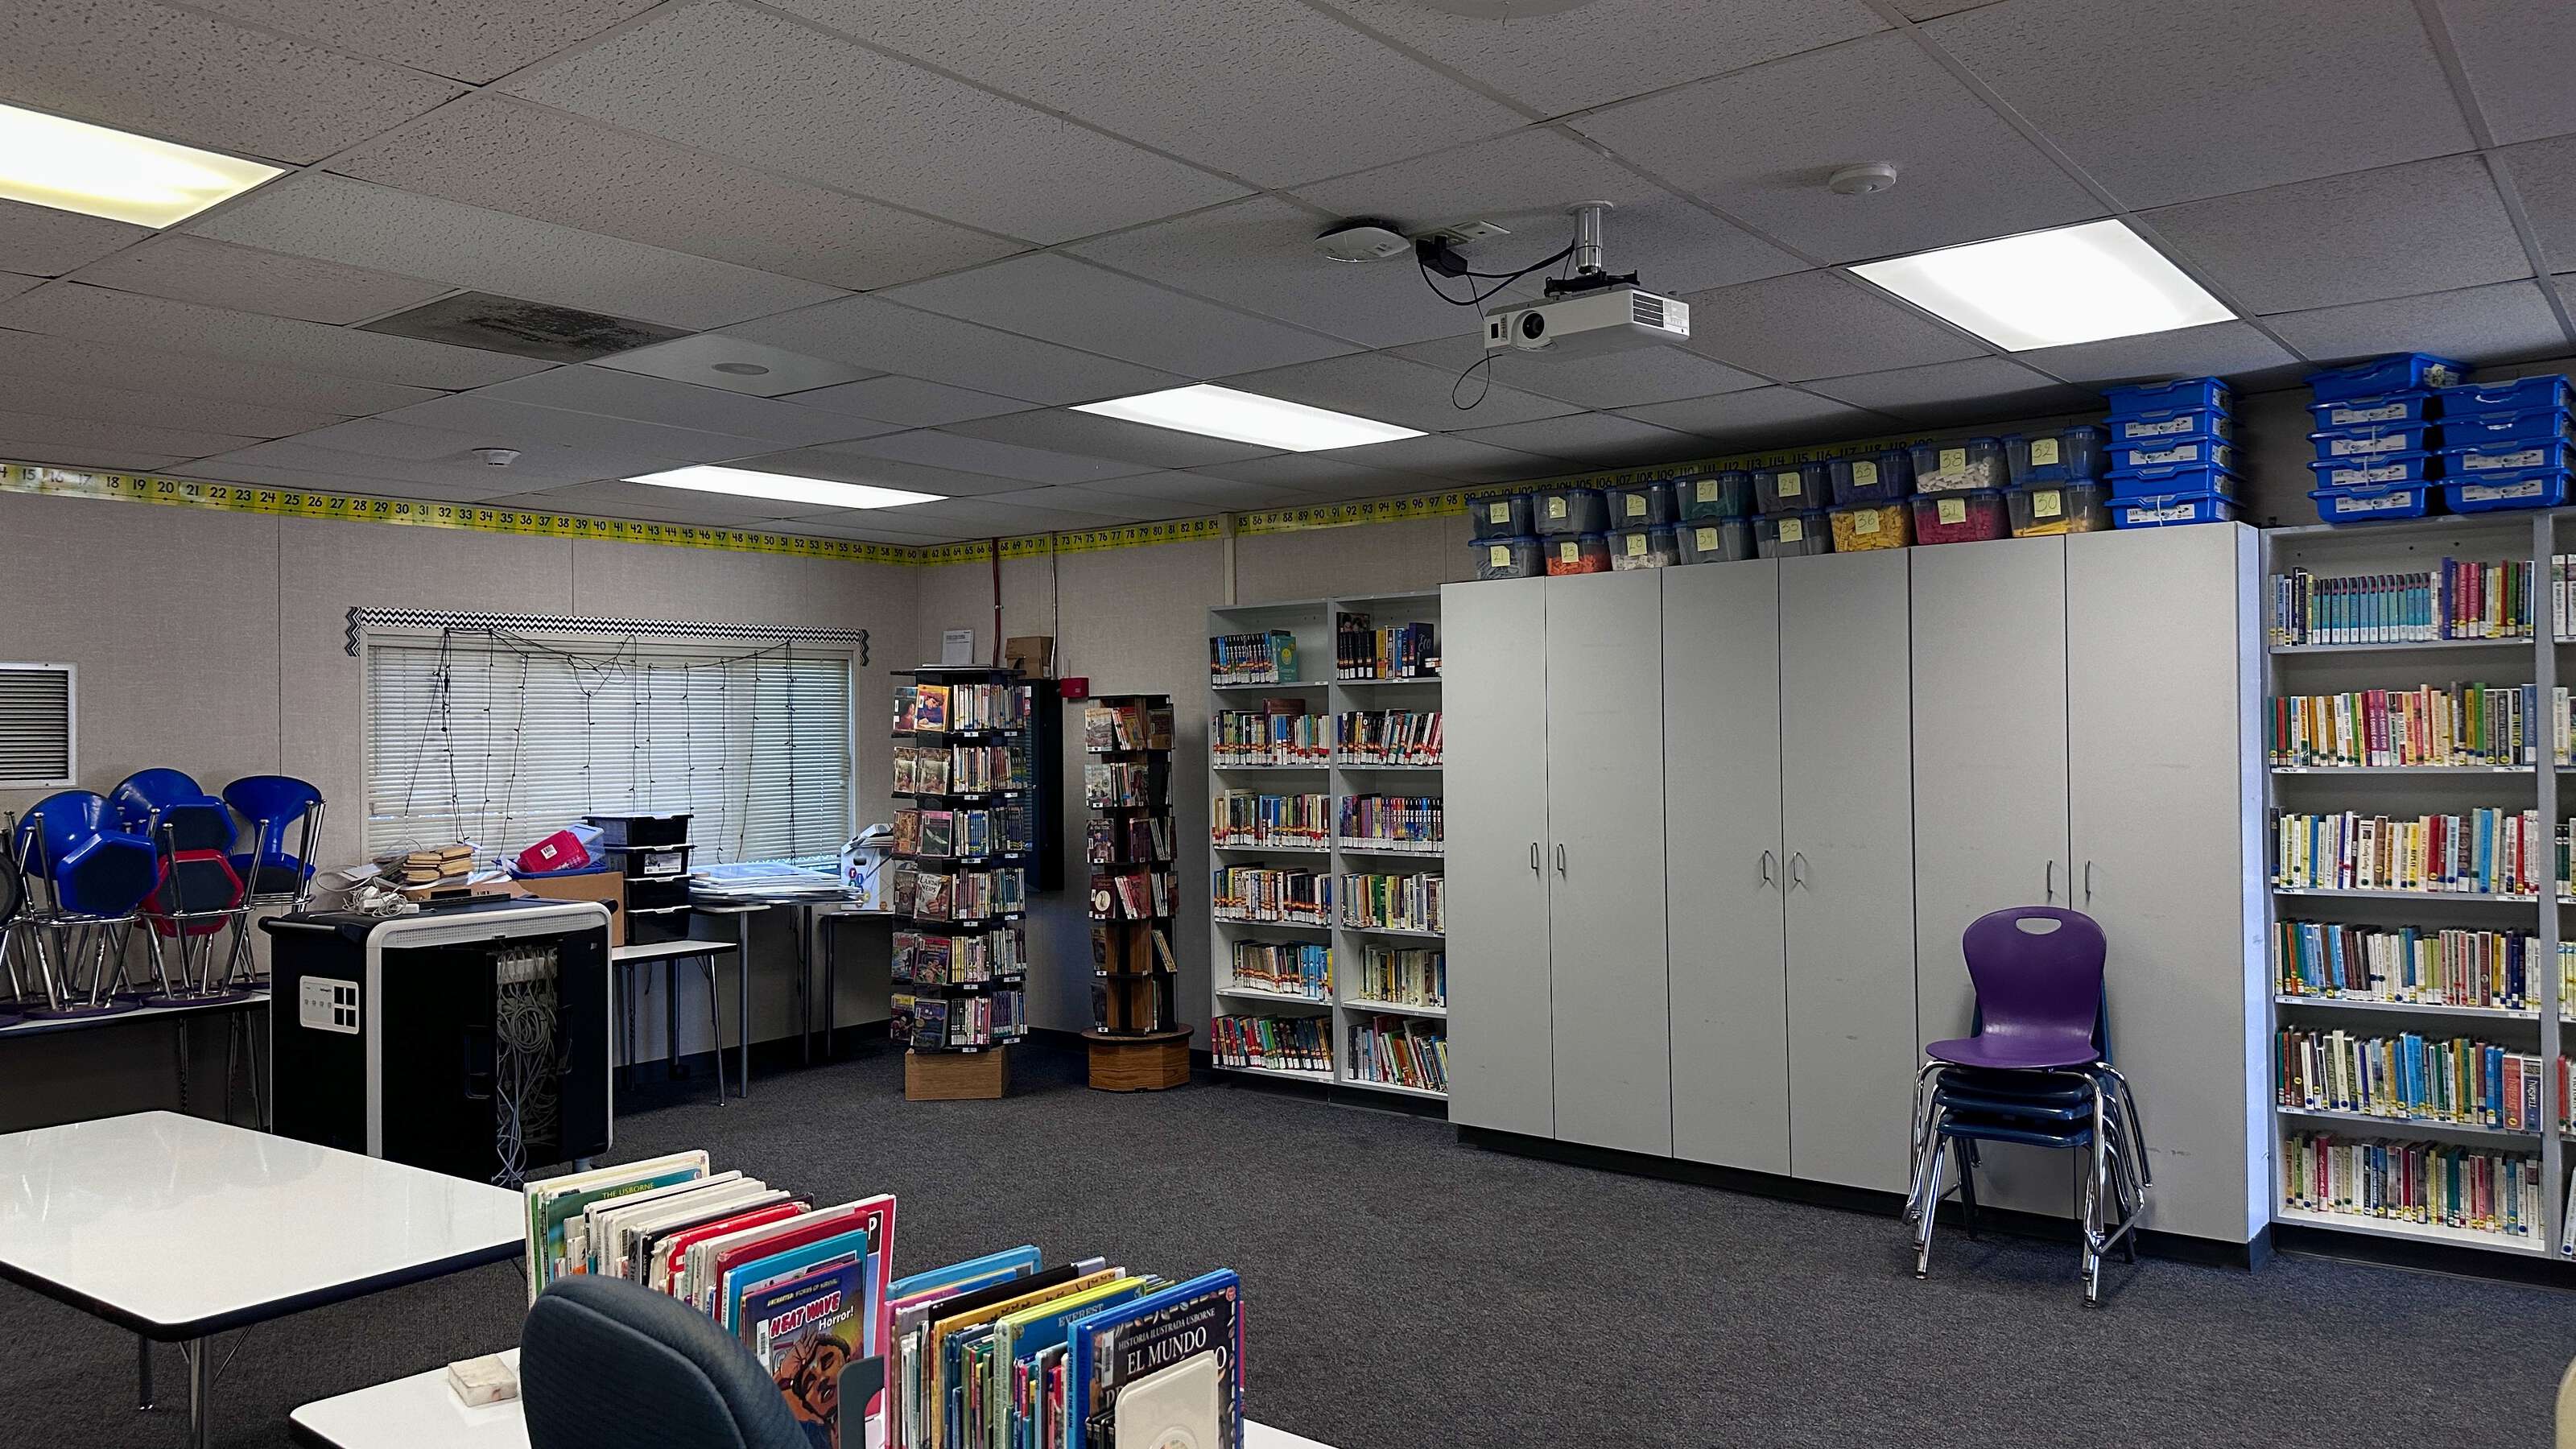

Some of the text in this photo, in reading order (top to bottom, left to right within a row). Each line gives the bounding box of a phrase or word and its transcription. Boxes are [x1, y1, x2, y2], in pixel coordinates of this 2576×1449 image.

[2033, 442, 2053, 458] 32
[1941, 453, 1963, 469] 38
[1492, 507, 1506, 518] 22
[2036, 493, 2057, 512] 30
[23, 469, 35, 481] 15
[107, 477, 120, 488] 18
[134, 479, 146, 490] 19
[158, 481, 174, 493] 20
[186, 485, 199, 497] 21
[210, 487, 226, 498] 22
[236, 489, 250, 501] 23
[260, 492, 275, 503] 24
[285, 494, 299, 506] 25
[308, 496, 322, 507] 26
[330, 498, 345, 509] 27
[353, 500, 367, 510] 28
[374, 502, 388, 512] 29
[395, 504, 409, 514] 30
[419, 506, 429, 515] 31
[439, 507, 451, 518] 32
[459, 510, 472, 519] 33
[480, 511, 493, 521] 34
[501, 513, 514, 523] 35
[520, 515, 532, 525] 36
[539, 517, 551, 526] 37
[558, 518, 569, 527] 38
[576, 519, 588, 529] 39
[594, 521, 606, 530] 40
[614, 522, 623, 531] 41
[630, 524, 642, 533] 42
[648, 526, 659, 535] 43
[665, 527, 676, 536] 44
[683, 529, 693, 538] 45
[699, 530, 710, 539] 46
[716, 531, 726, 540] 47
[733, 533, 743, 542] 48
[748, 535, 759, 543] 49
[765, 536, 774, 545] 50
[781, 538, 788, 547] 51
[795, 539, 804, 547] 52
[810, 540, 819, 549] 53
[824, 542, 834, 551] 54
[839, 543, 848, 551] 55
[853, 544, 862, 553] 56
[867, 546, 876, 555] 57
[907, 550, 916, 559] 60
[1857, 514, 1875, 528] 36
[965, 546, 973, 555] 65
[976, 544, 985, 553] 66
[1000, 542, 1009, 551] 68
[1012, 541, 1021, 550] 69
[1025, 539, 1034, 548] 70
[1038, 539, 1045, 547] 71
[1062, 536, 1070, 545] 73
[1074, 535, 1082, 543] 74
[1085, 534, 1095, 543] 75
[1098, 533, 1108, 541] 76
[1111, 531, 1121, 540] 77
[1125, 530, 1135, 538] 78
[1139, 528, 1149, 537] 79
[1153, 526, 1162, 535] 80
[1168, 526, 1175, 534] 81
[1181, 523, 1190, 532] 82
[1195, 522, 1203, 530] 83
[1208, 521, 1218, 529] 84
[1238, 518, 1248, 526] 85
[1253, 516, 1262, 525] 86
[1267, 514, 1277, 523] 87
[1283, 513, 1293, 522] 88
[1298, 511, 1308, 520] 89
[1314, 510, 1324, 518] 90
[1331, 508, 1340, 517] 91
[1346, 506, 1356, 515] 92
[1362, 505, 1373, 514] 93
[1378, 502, 1389, 512] 94
[1396, 501, 1406, 510] 95
[1412, 499, 1423, 509] 96
[1430, 497, 1441, 506] 97
[1446, 495, 1457, 505] 98
[1494, 550, 1505, 561] 21
[602, 1182, 654, 1199] THE USBORNE
[770, 1290, 841, 1339] HEAT WAVE
[819, 1306, 854, 1330] Horror!
[1058, 1303, 1104, 1327] EVEREST
[1118, 1307, 1216, 1350] HISTORIA ILUSTRADA USBORNE
[1127, 1352, 1146, 1375] EL
[1148, 1326, 1207, 1368] MUNDO
